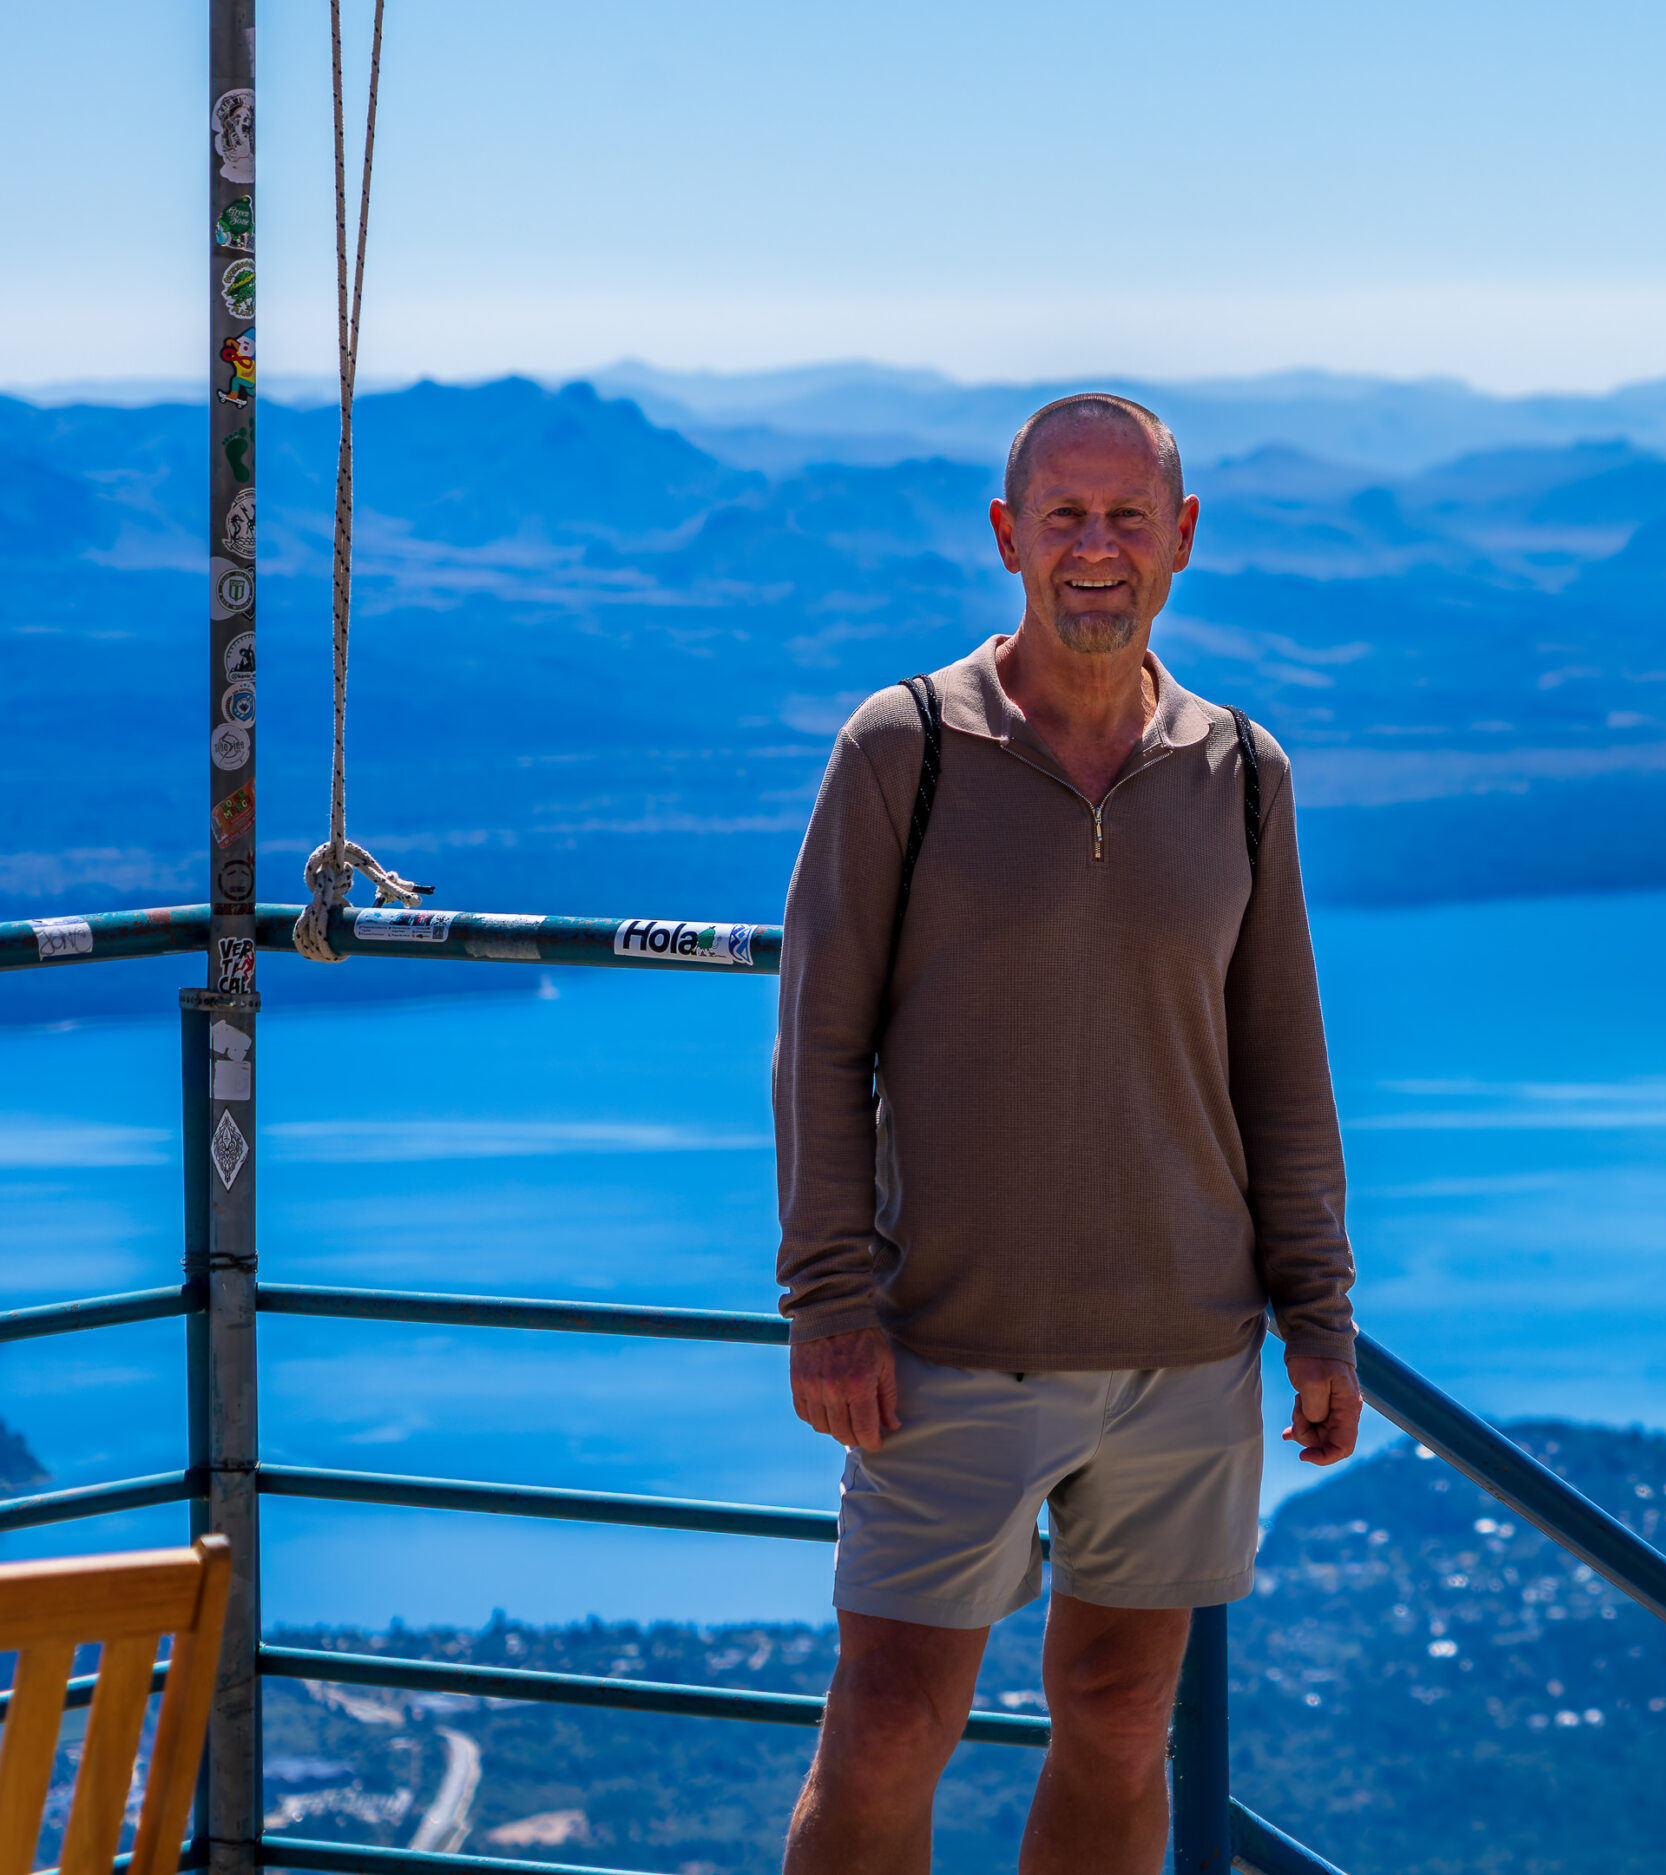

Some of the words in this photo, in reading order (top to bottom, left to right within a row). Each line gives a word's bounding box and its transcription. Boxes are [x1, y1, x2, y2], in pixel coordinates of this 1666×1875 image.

[623, 920, 698, 956] Hola
[220, 939, 253, 959] VER
[219, 976, 249, 994] CAL
